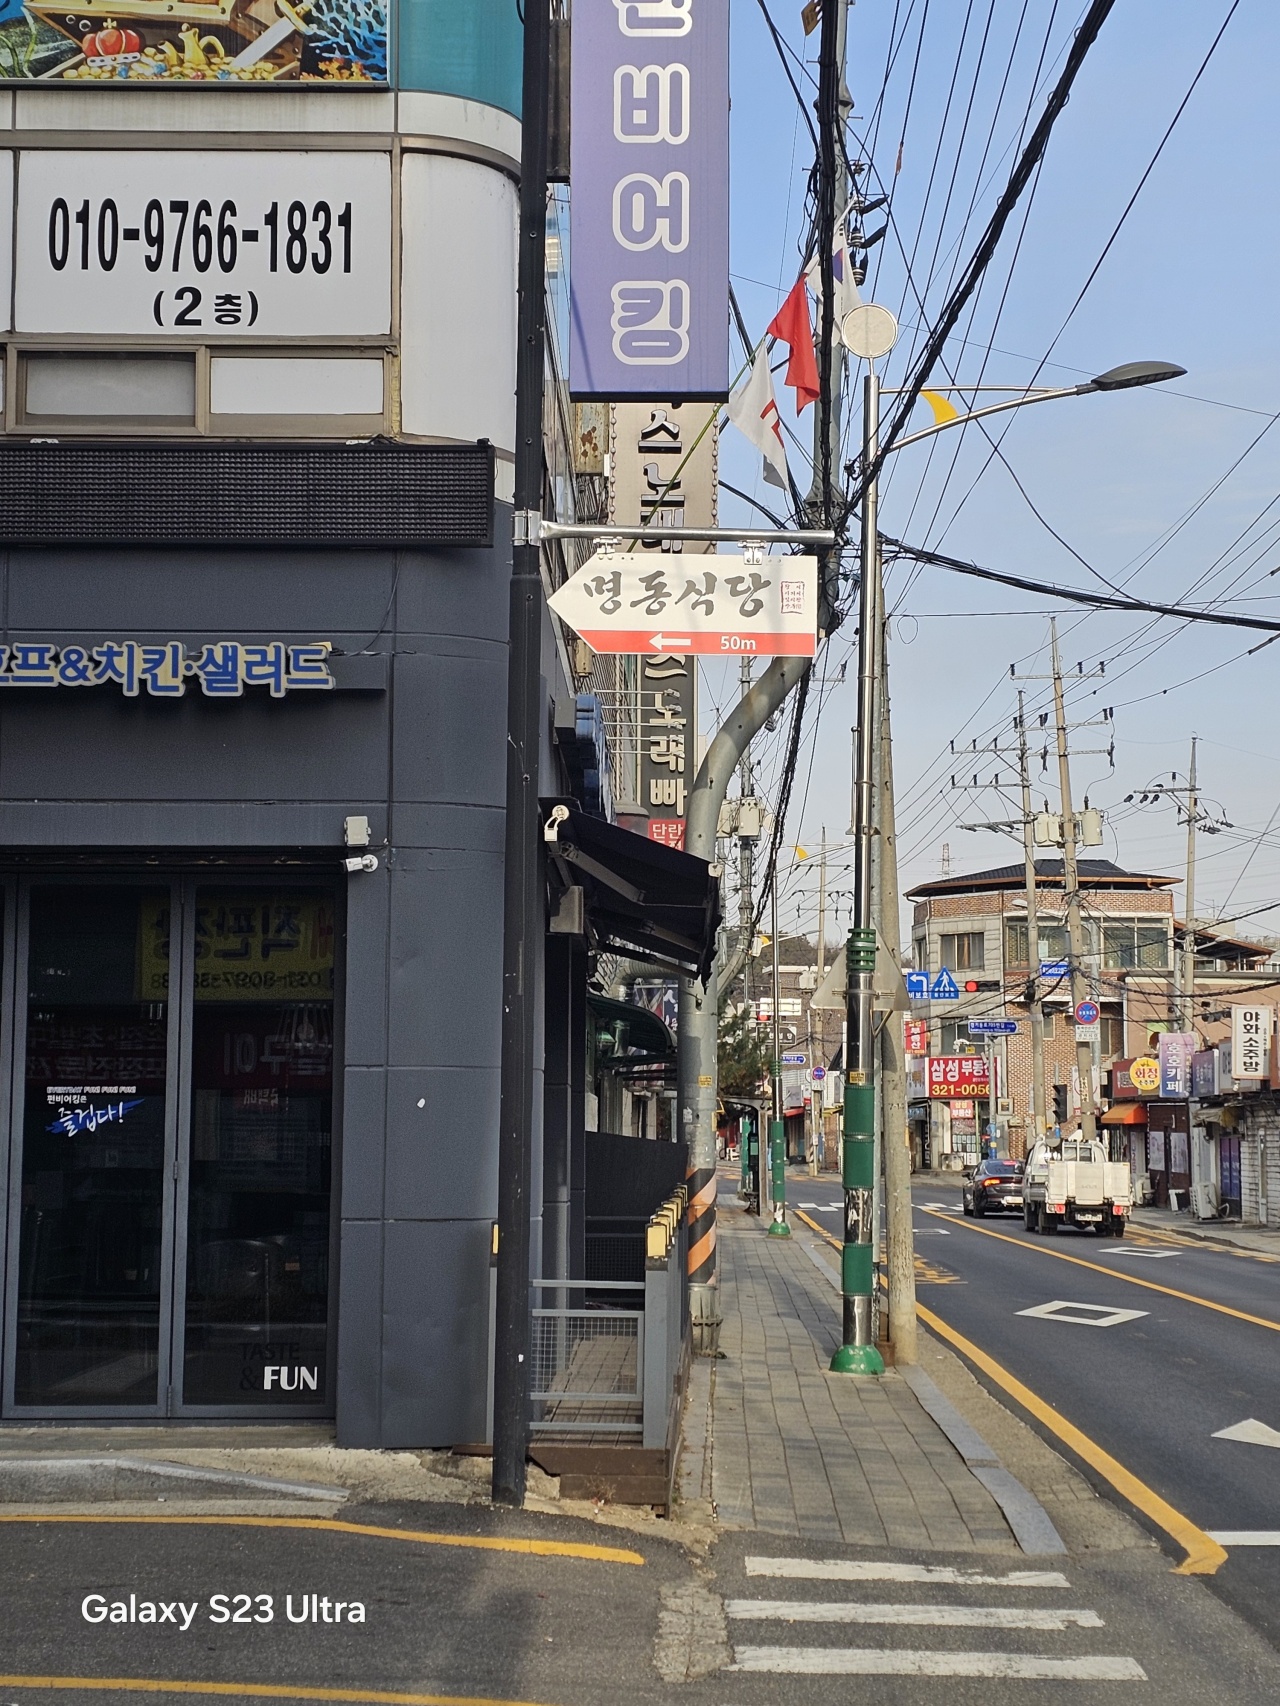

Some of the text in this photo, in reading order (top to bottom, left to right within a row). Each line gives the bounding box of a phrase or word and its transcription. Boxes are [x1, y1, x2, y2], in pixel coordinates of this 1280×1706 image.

[47, 197, 353, 274] 010-9766-1831
[583, 570, 772, 618] 명동식당
[720, 635, 757, 651] 50m
[0, 640, 336, 698] 프&치킨·샐러드
[652, 823, 684, 839] 단란
[931, 1060, 959, 1082] 삼성
[57, 1101, 124, 1138] 즐겁다!
[263, 1365, 318, 1391] FUN
